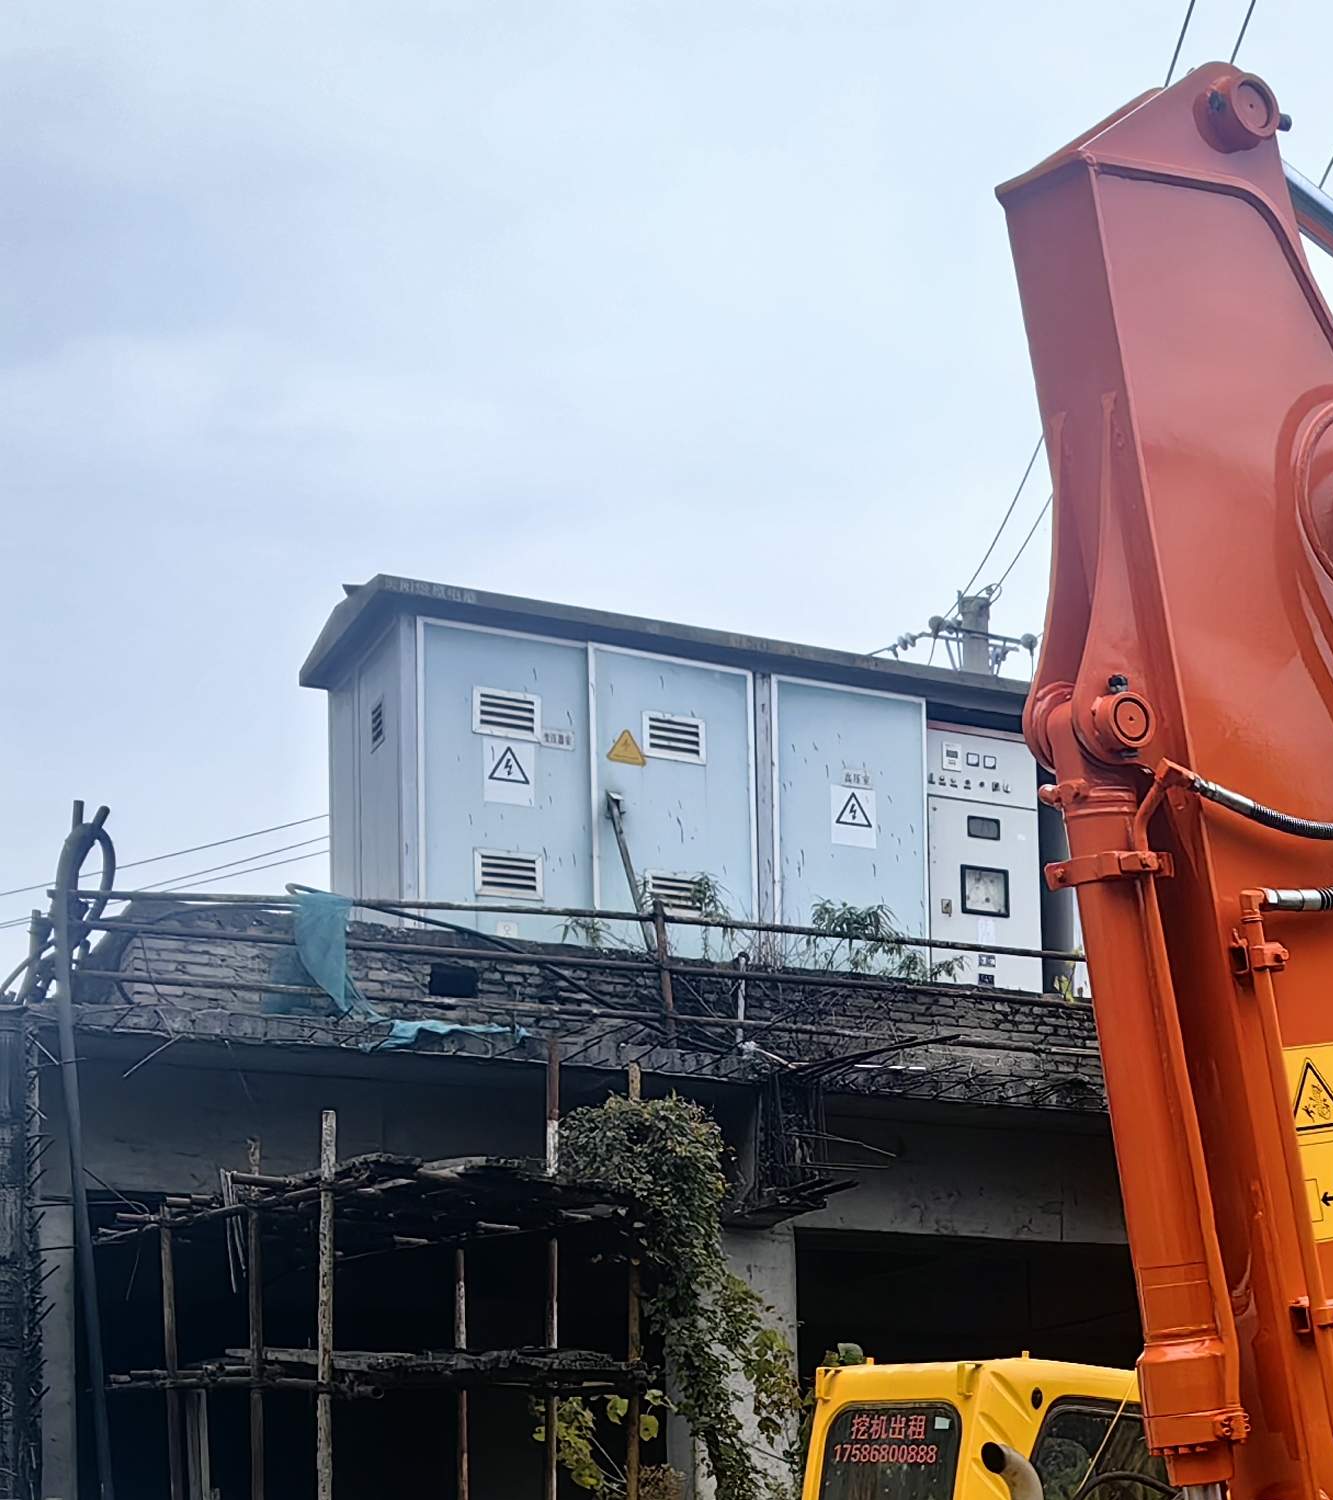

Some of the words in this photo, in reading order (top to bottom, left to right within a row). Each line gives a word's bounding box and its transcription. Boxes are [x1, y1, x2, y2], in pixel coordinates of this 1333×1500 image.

[851, 1414, 926, 1440] 挖机出租
[834, 1444, 937, 1463] 17586800888
